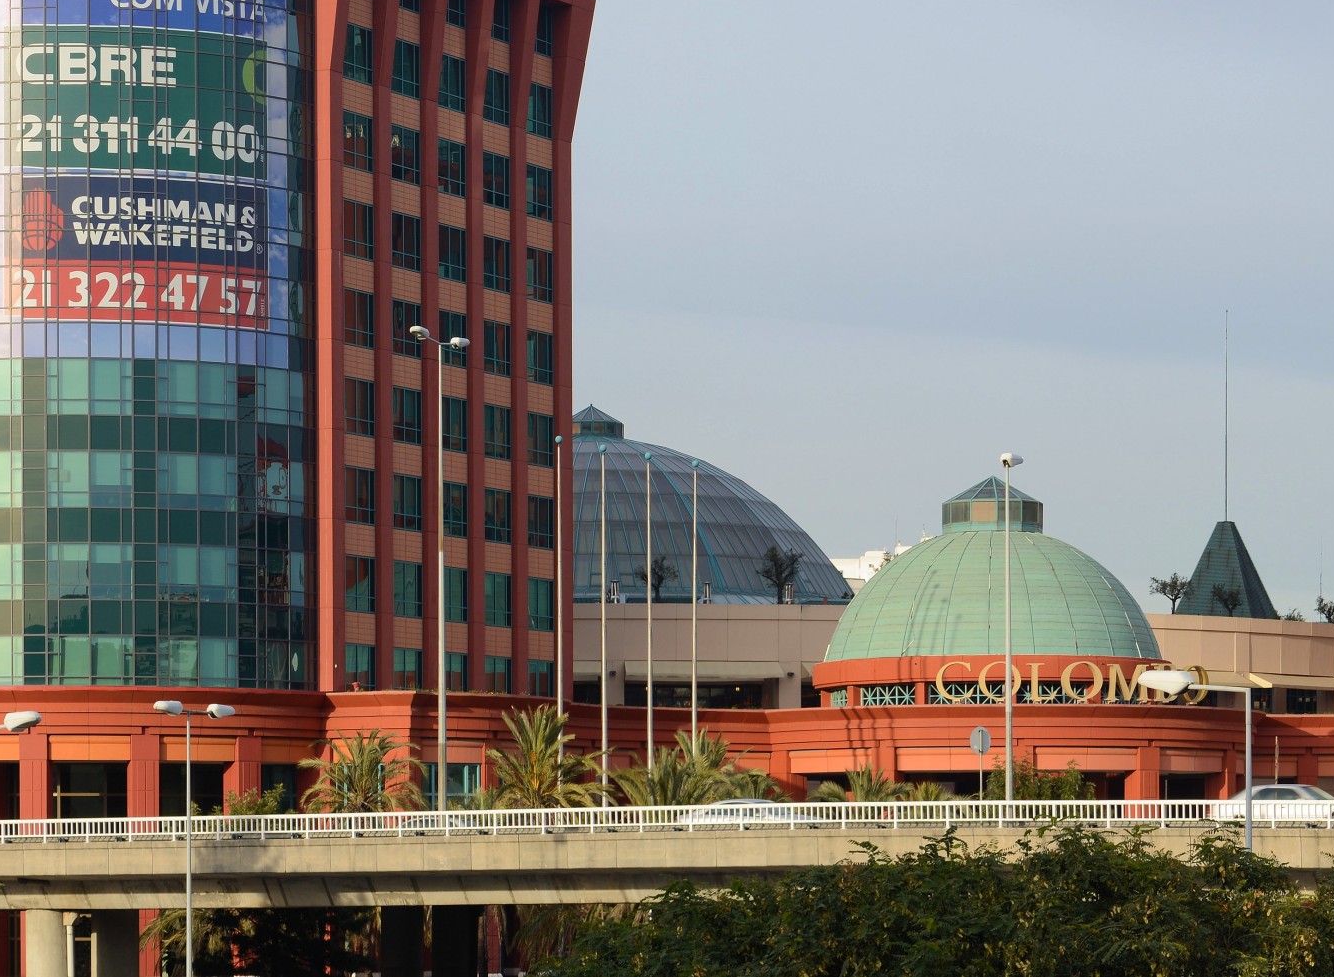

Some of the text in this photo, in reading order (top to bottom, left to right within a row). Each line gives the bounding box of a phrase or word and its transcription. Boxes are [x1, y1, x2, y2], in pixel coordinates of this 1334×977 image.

[15, 43, 177, 87] CBRE
[16, 114, 62, 152] 21
[72, 114, 139, 154] 311
[147, 117, 203, 157] 44
[211, 121, 261, 163] 00
[71, 195, 258, 228] CUSHMAN &
[72, 221, 255, 252] WAKEFIELD
[13, 269, 52, 308] 21
[68, 270, 148, 309] 322
[160, 273, 209, 311] 47
[219, 277, 262, 316] 57
